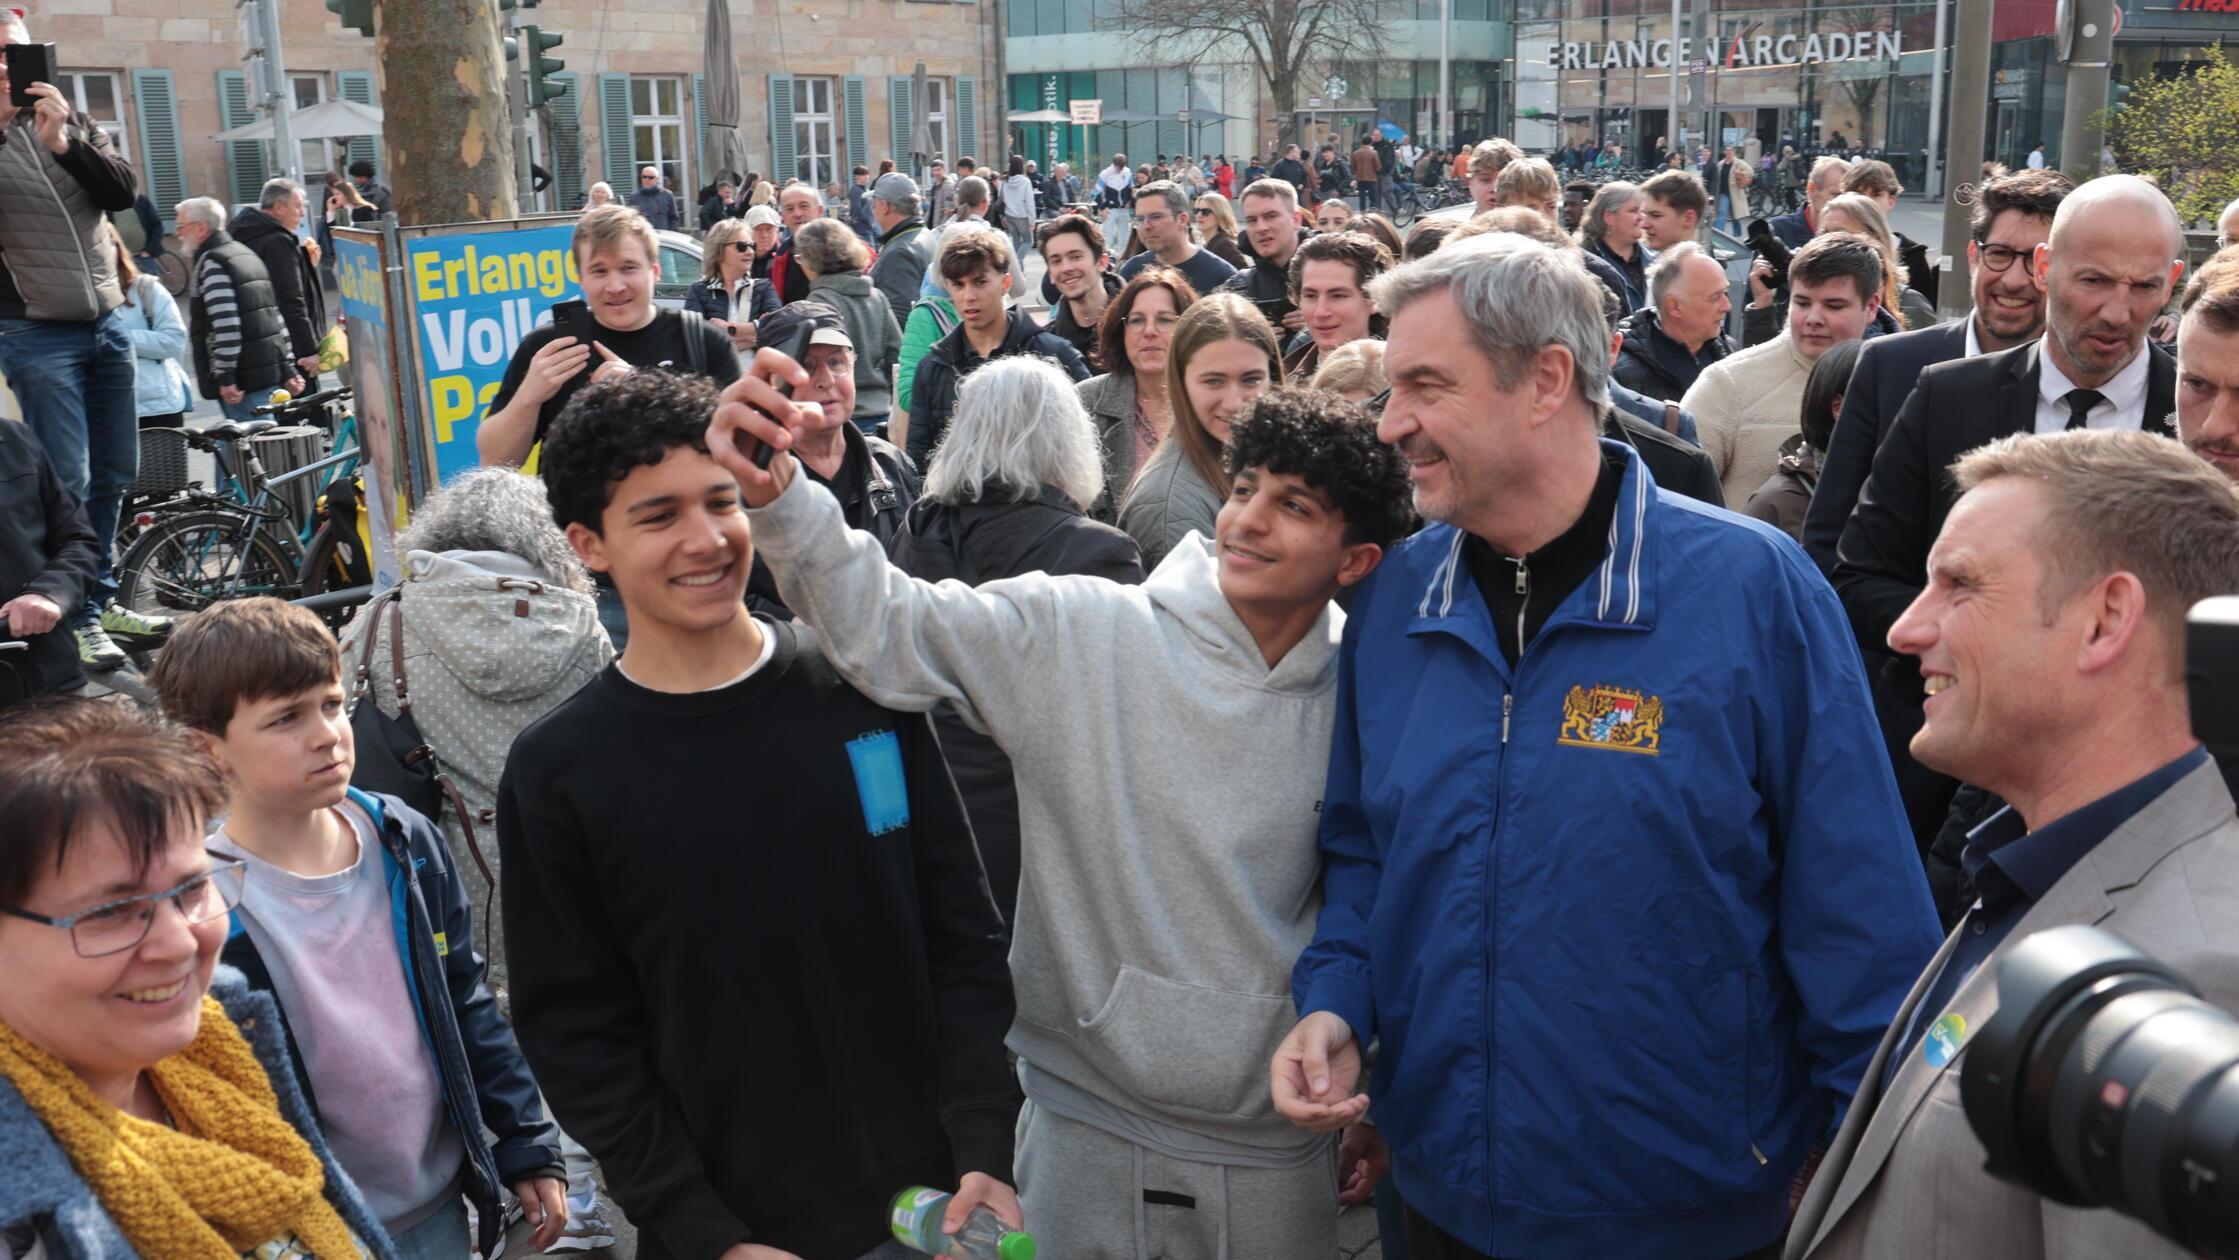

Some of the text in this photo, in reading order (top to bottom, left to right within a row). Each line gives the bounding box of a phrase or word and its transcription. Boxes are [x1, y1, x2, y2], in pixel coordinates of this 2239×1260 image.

[1546, 38, 1718, 70] ERLANGEN
[1725, 29, 1902, 69] ARCADEN
[422, 297, 556, 371] Voll
